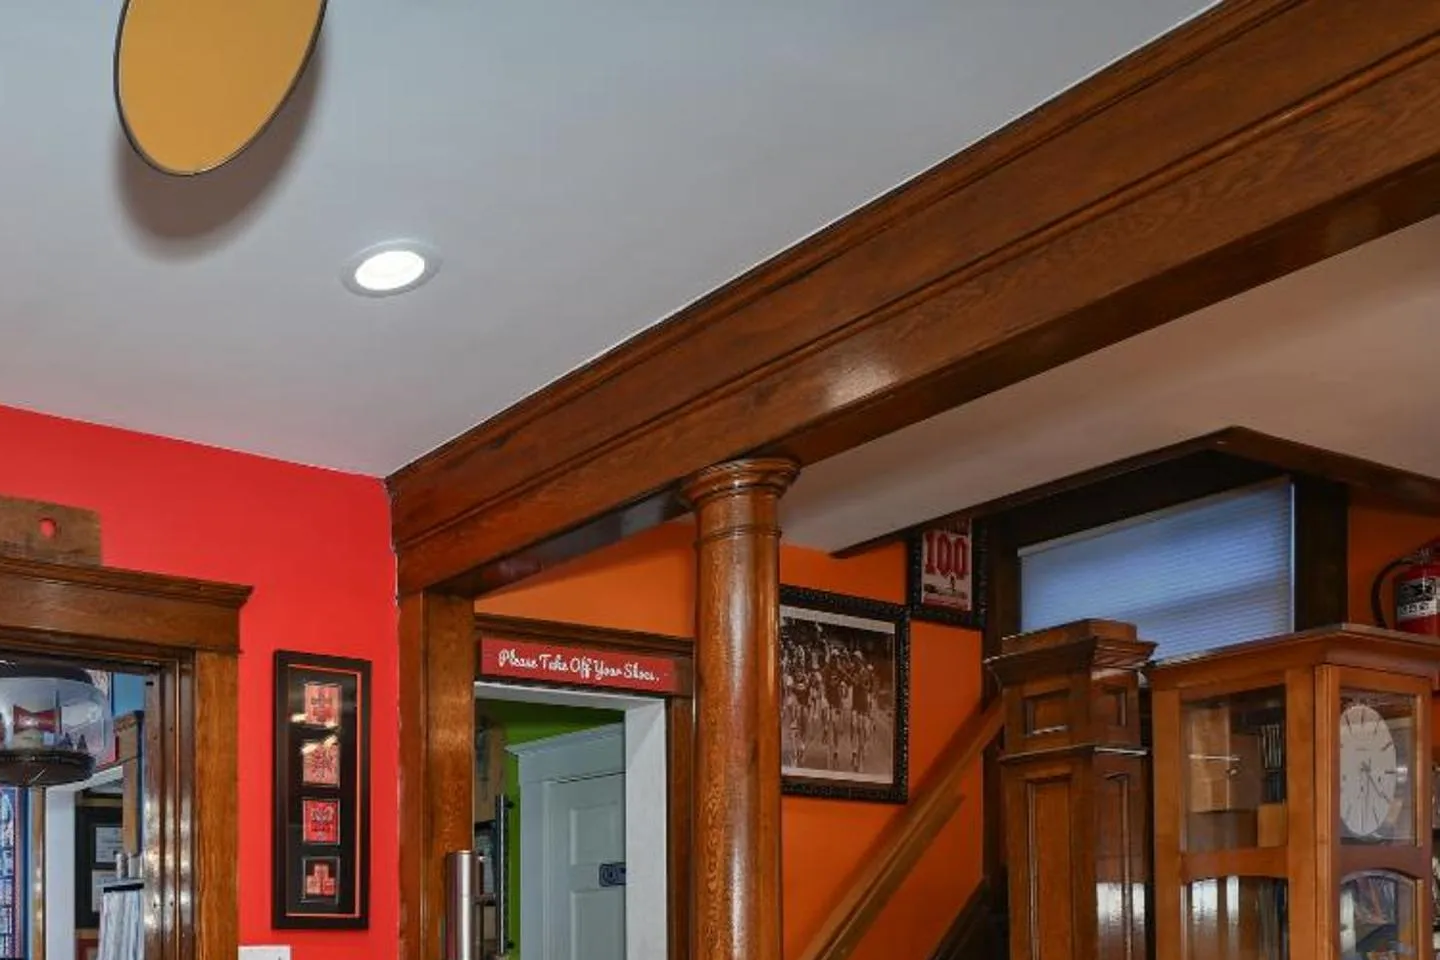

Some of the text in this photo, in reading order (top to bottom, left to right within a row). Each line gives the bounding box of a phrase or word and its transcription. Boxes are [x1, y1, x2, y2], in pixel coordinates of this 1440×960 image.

[498, 649, 538, 667] Please
[539, 654, 569, 672] Take
[570, 656, 592, 679] Off
[593, 660, 622, 680] Your
